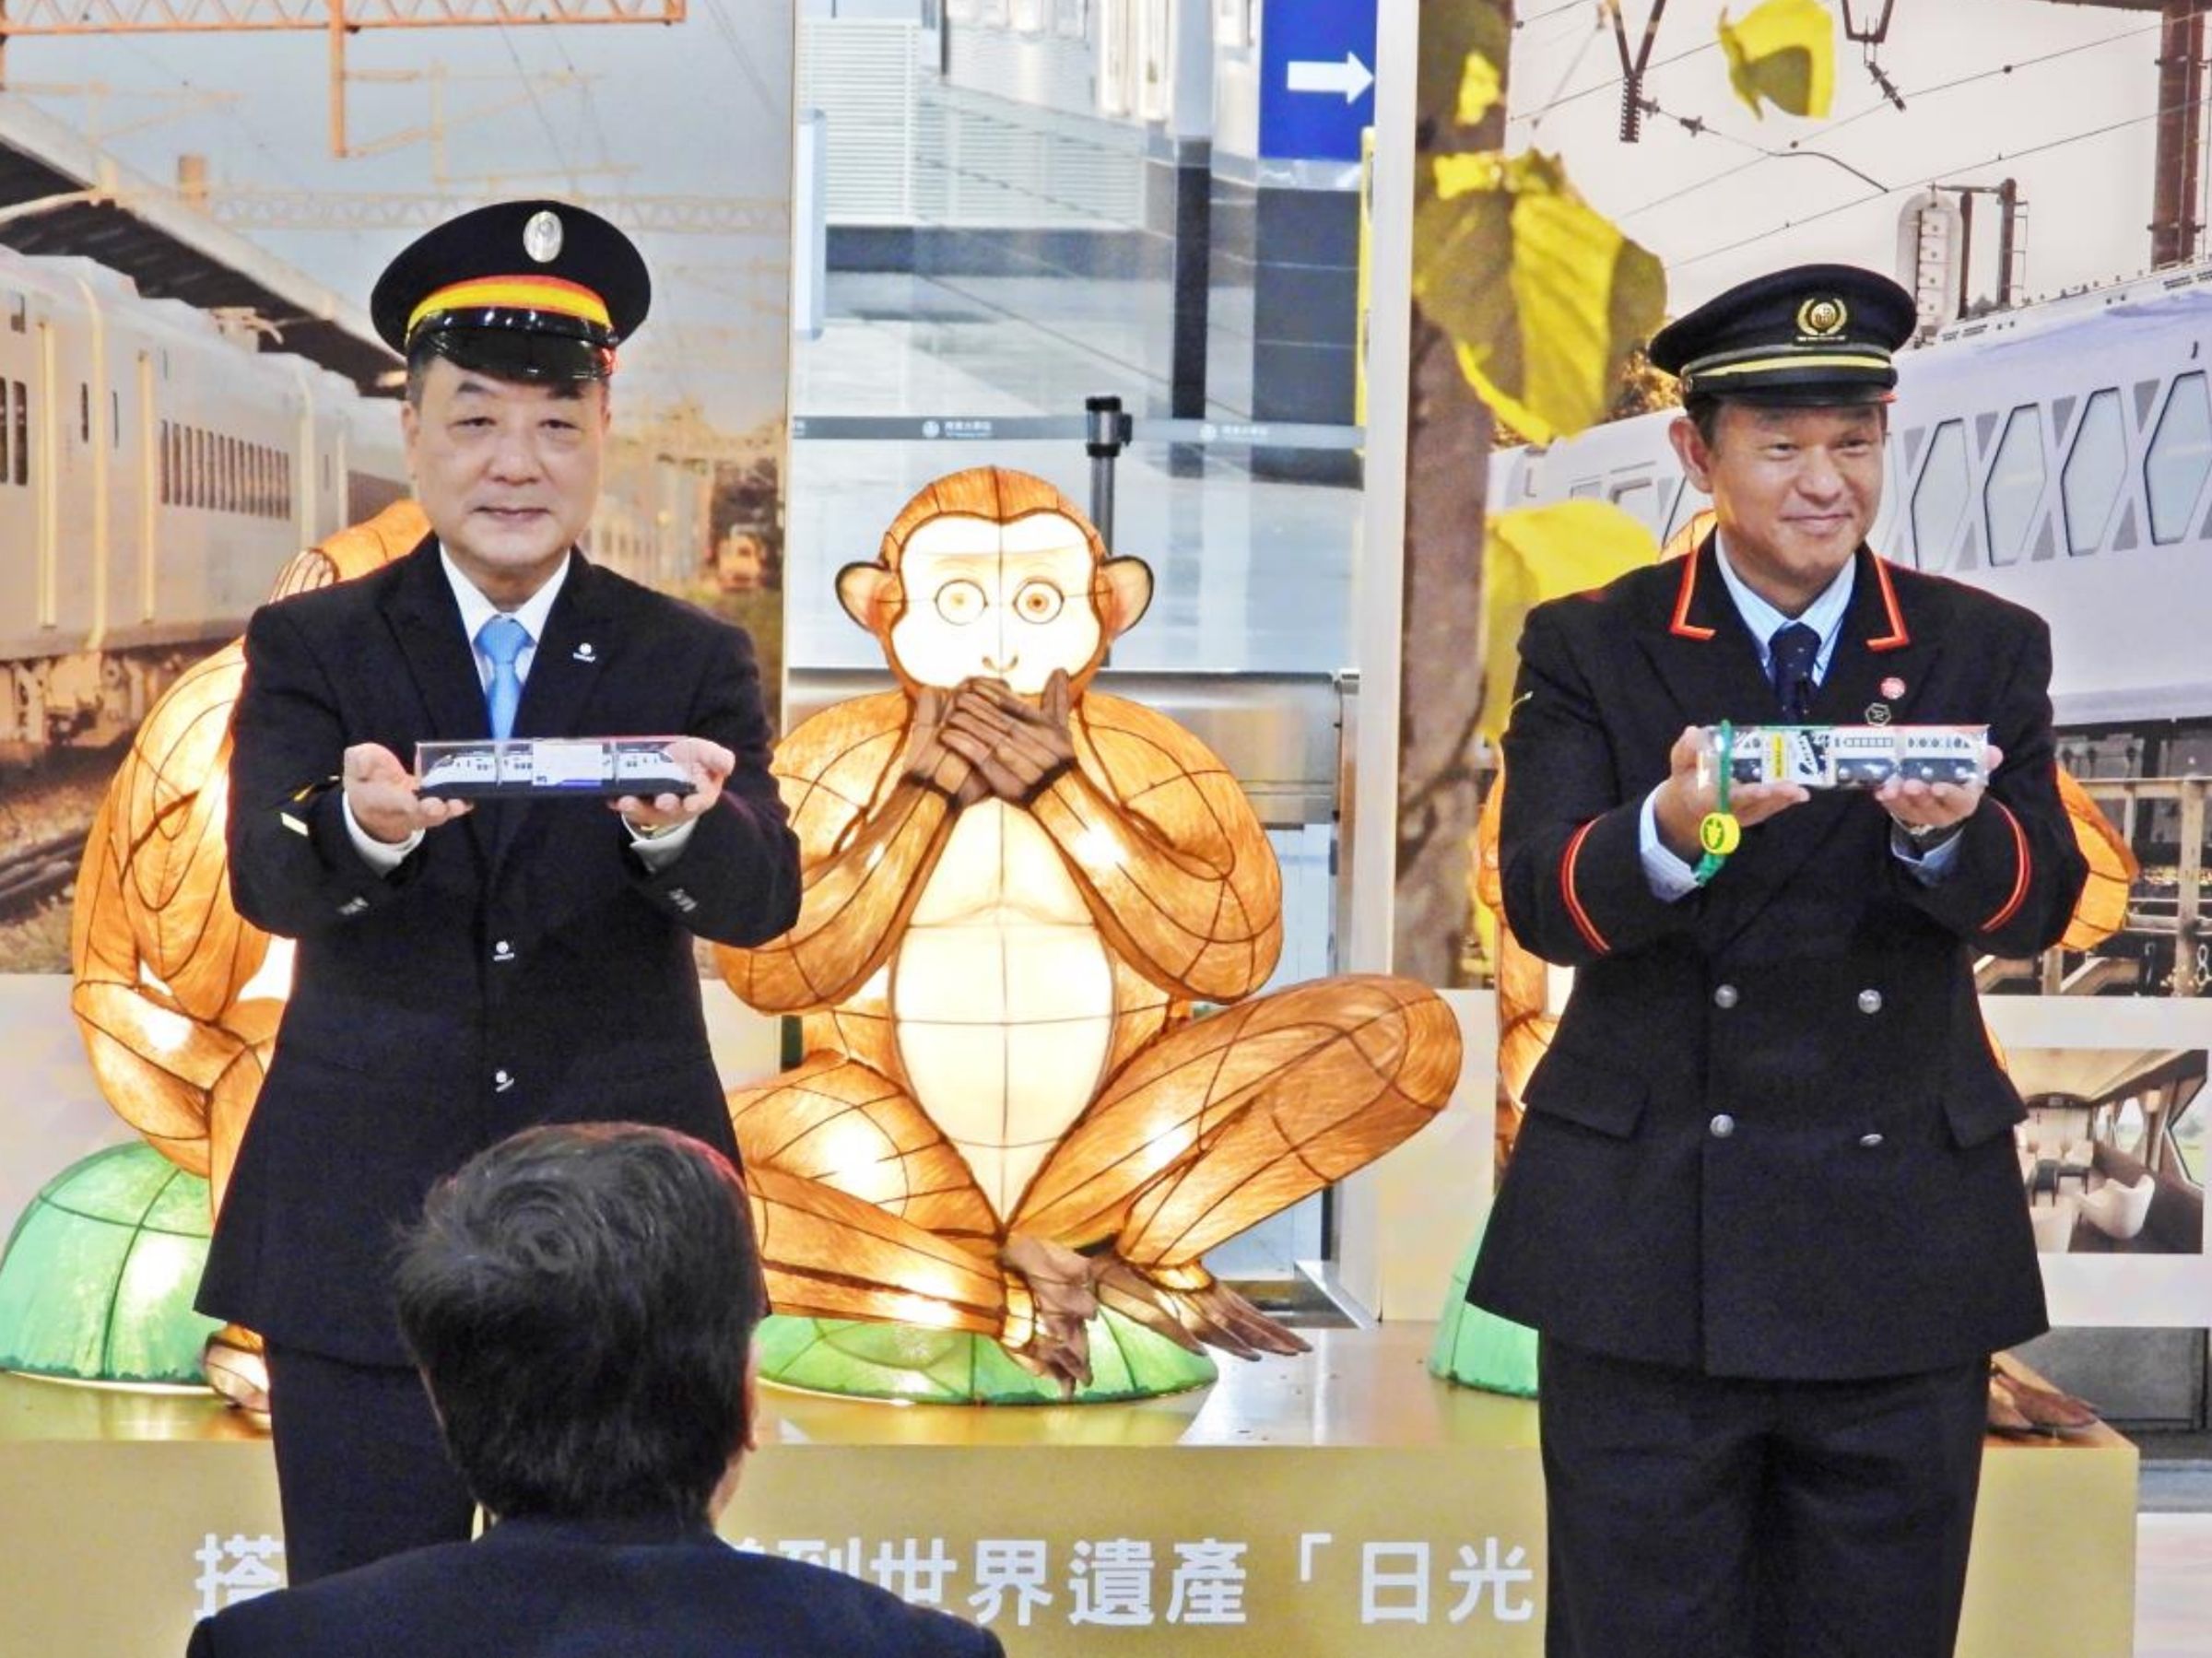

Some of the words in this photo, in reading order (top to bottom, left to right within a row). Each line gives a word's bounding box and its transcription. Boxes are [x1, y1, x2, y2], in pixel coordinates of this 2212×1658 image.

[735, 1532, 1534, 1626] 世界遺產「日光
